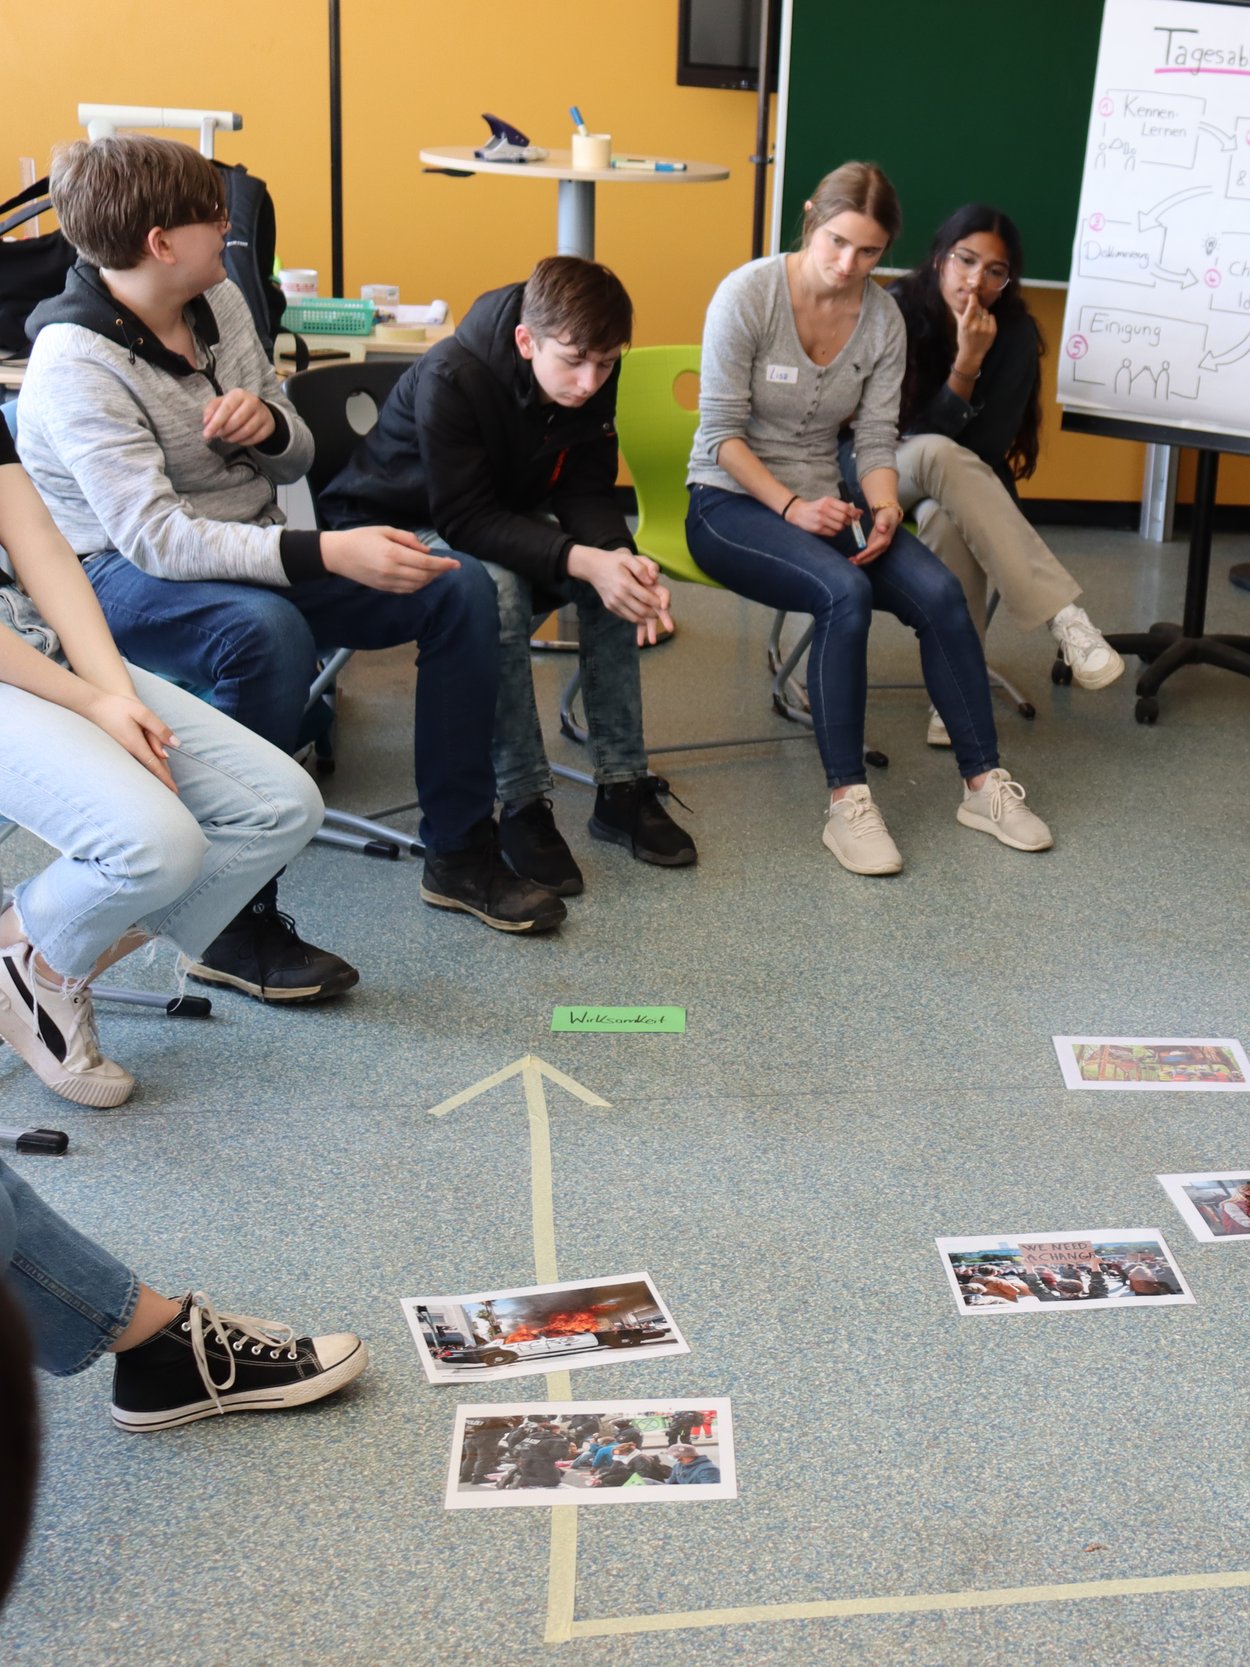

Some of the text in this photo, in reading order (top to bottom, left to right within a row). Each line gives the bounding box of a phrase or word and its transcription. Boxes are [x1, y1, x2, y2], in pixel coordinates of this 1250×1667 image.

[1140, 122, 1187, 138] Lernen
[1236, 170, 1247, 187] &
[1089, 312, 1162, 347] Einigung
[570, 1011, 666, 1025] Wirksamkeit
[1021, 1241, 1088, 1252] WE NEED
